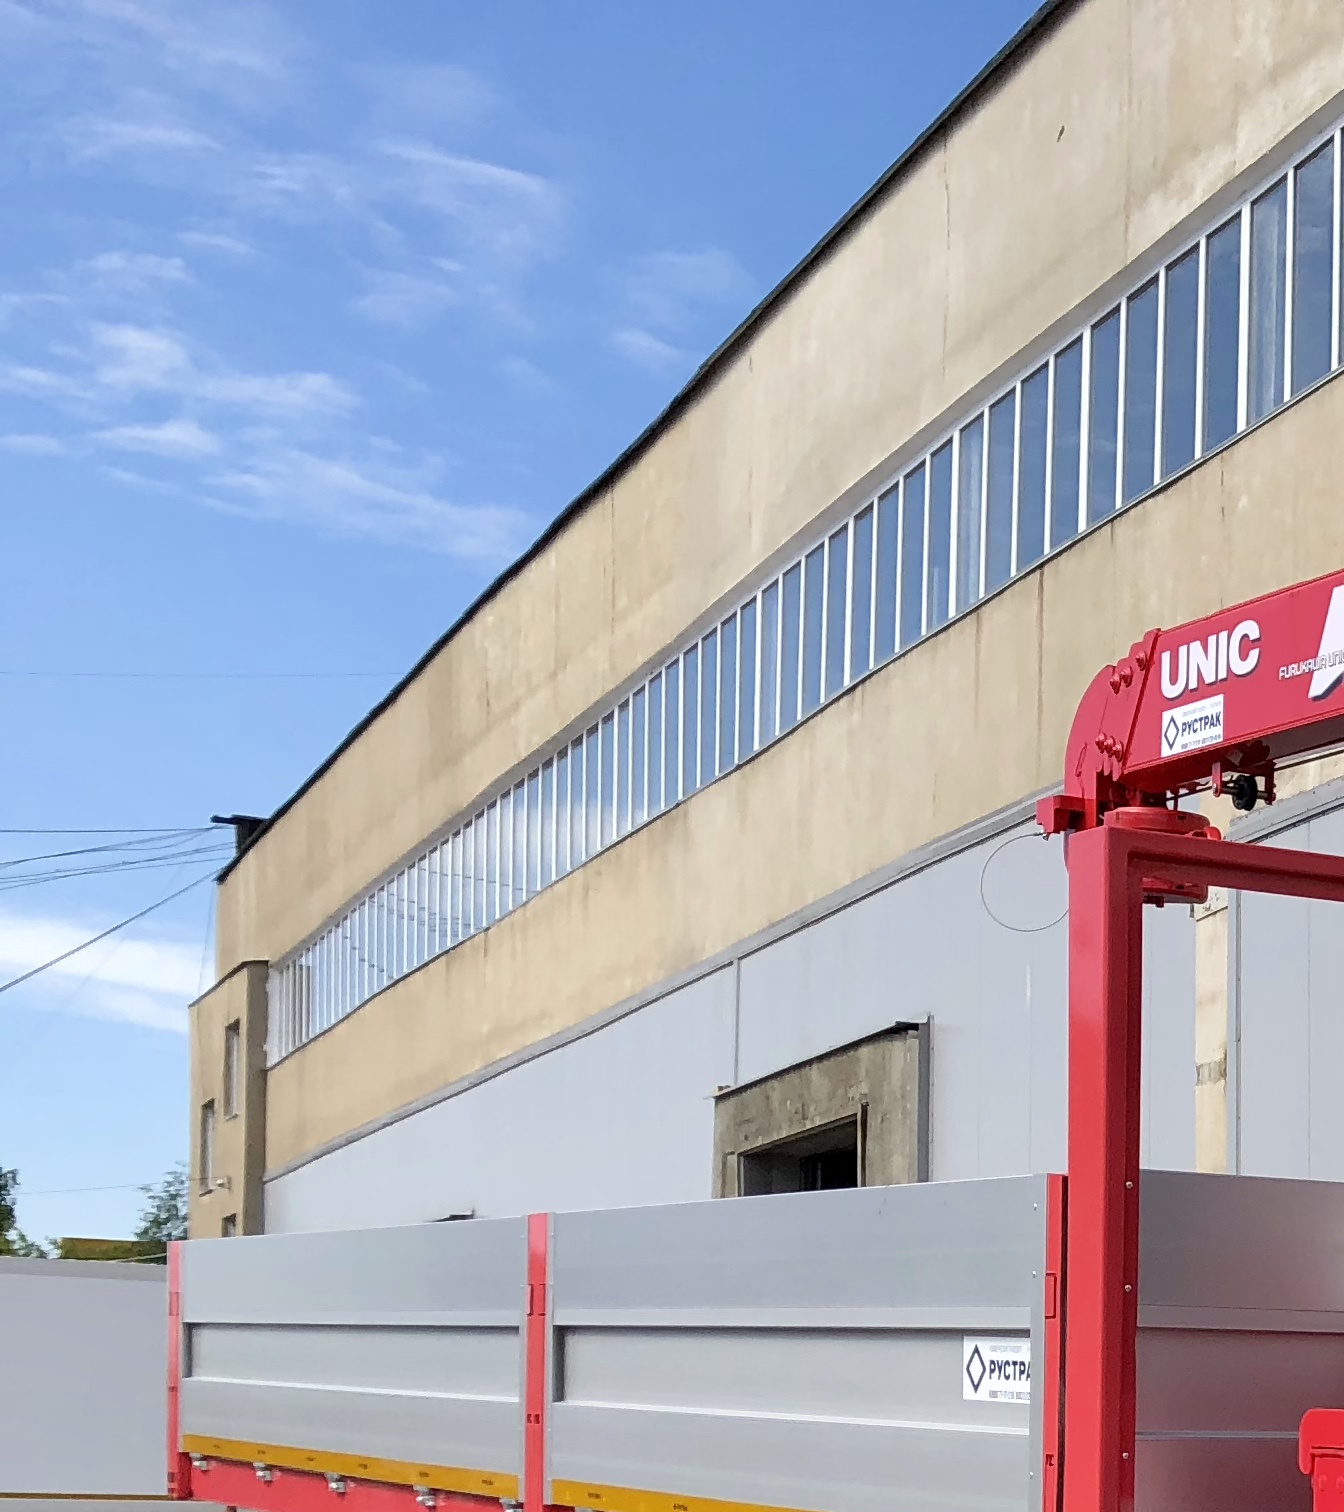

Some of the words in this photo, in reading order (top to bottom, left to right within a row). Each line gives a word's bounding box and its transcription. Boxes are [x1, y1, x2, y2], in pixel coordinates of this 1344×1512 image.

[1161, 619, 1261, 700] UNIC
[1279, 655, 1327, 680] FURUKAWA
[1181, 711, 1221, 737] РУСТРАК
